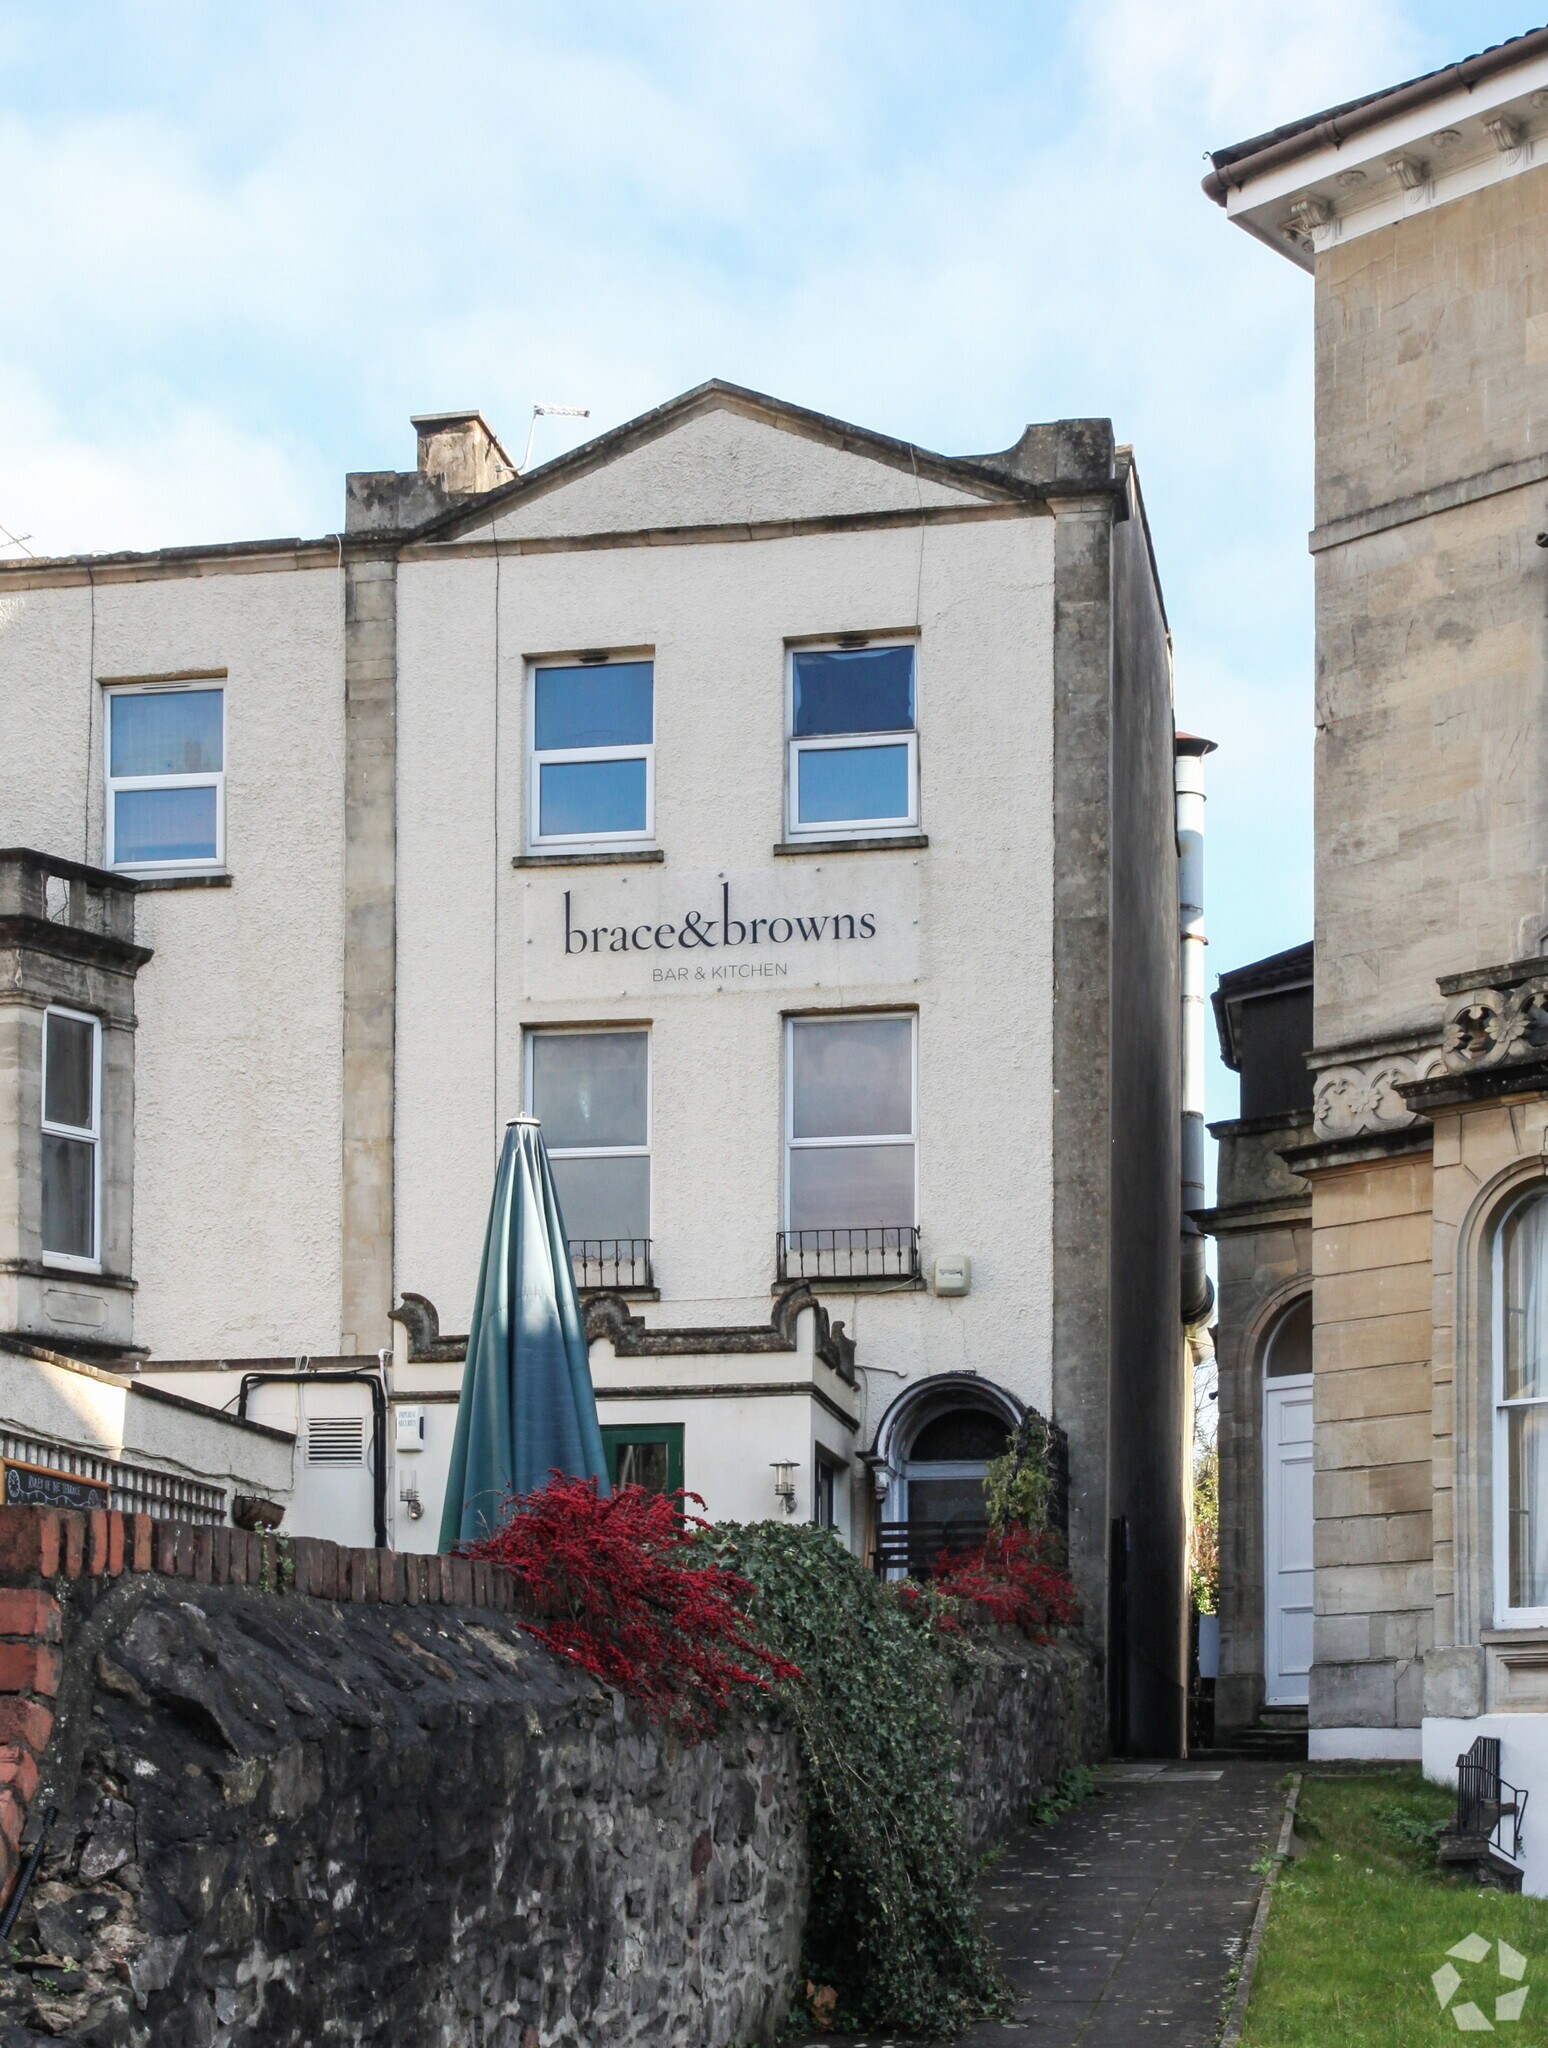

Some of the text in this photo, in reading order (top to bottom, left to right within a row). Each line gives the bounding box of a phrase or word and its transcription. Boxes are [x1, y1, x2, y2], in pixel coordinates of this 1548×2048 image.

[563, 881, 877, 955] brace&browns
[652, 962, 788, 982] BAR & KITCHEN
